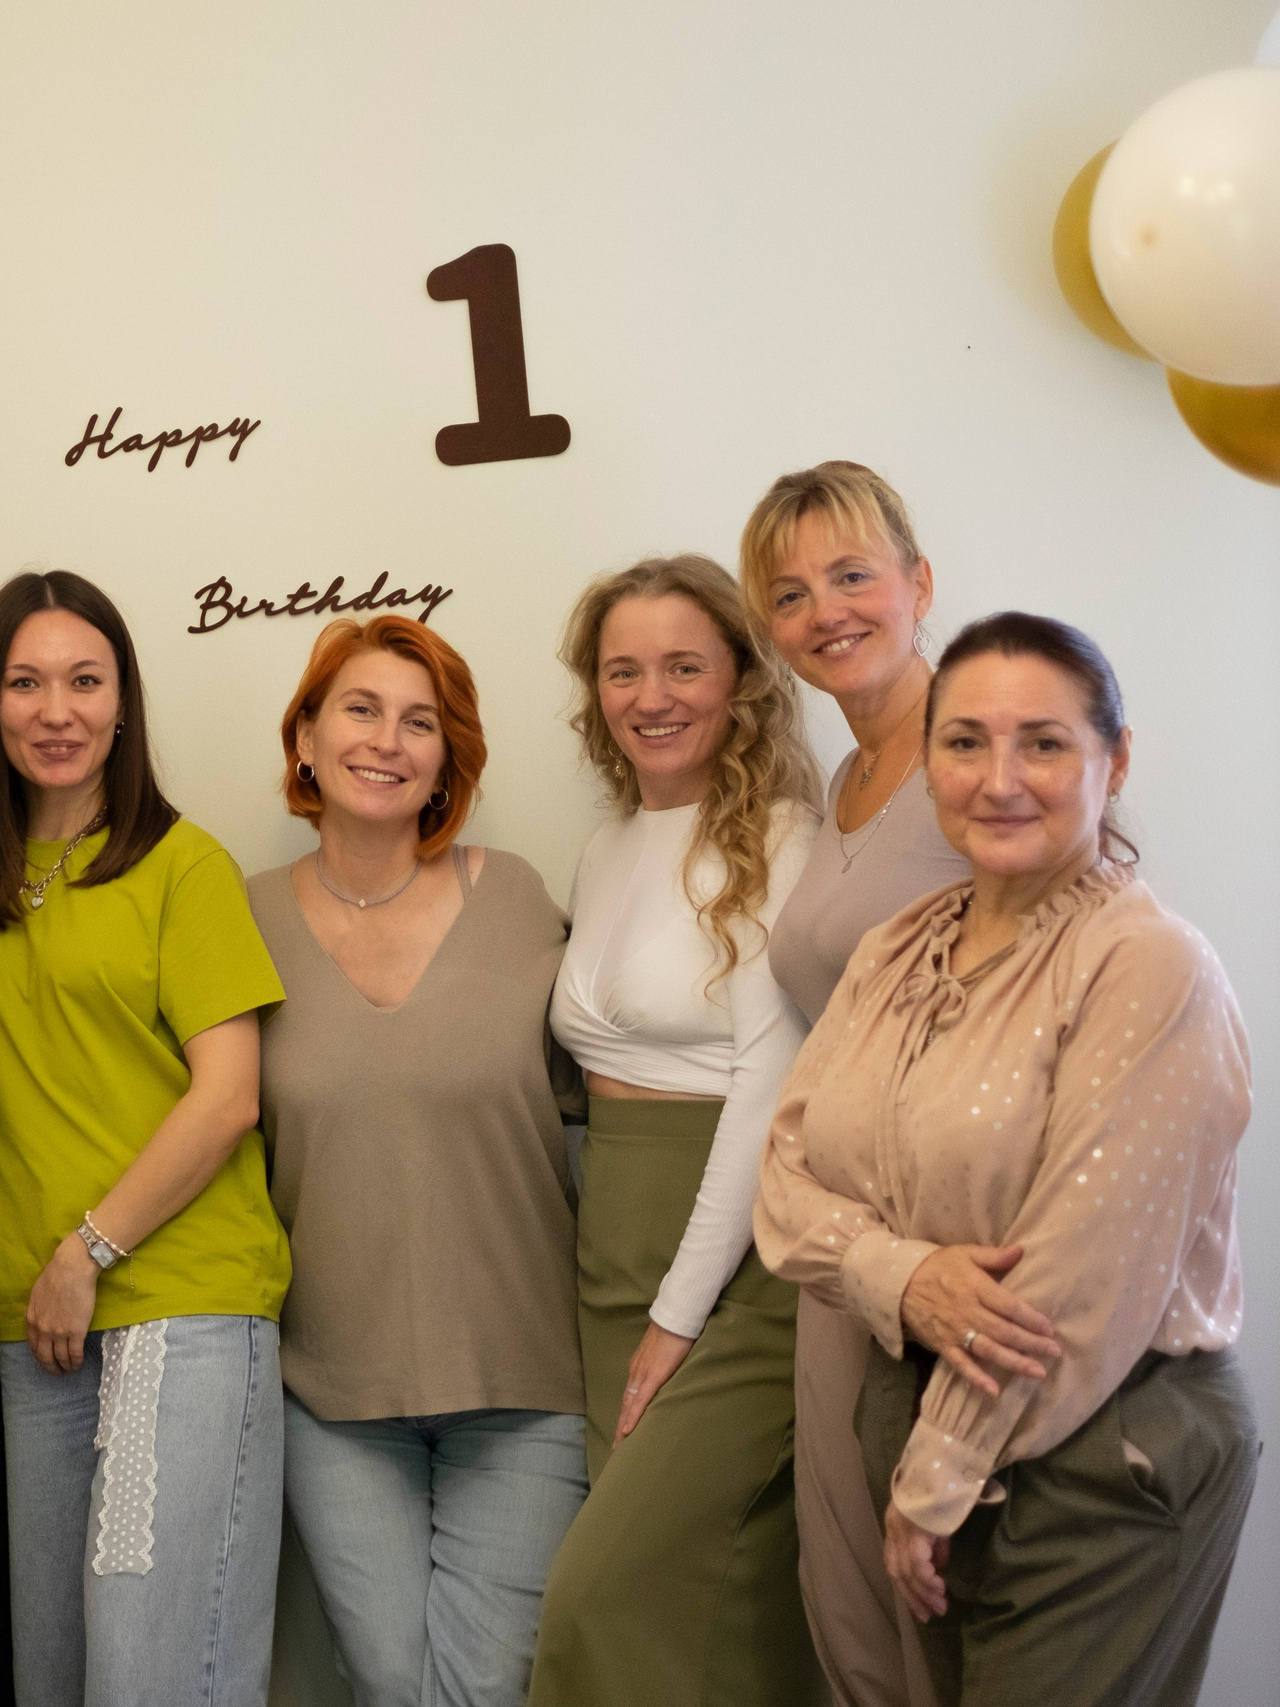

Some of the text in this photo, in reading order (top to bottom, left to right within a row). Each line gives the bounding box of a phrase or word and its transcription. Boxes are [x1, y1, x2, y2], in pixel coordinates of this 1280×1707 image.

[426, 243, 572, 467] 1
[64, 406, 262, 473] Happy
[187, 570, 454, 634] Birthday
